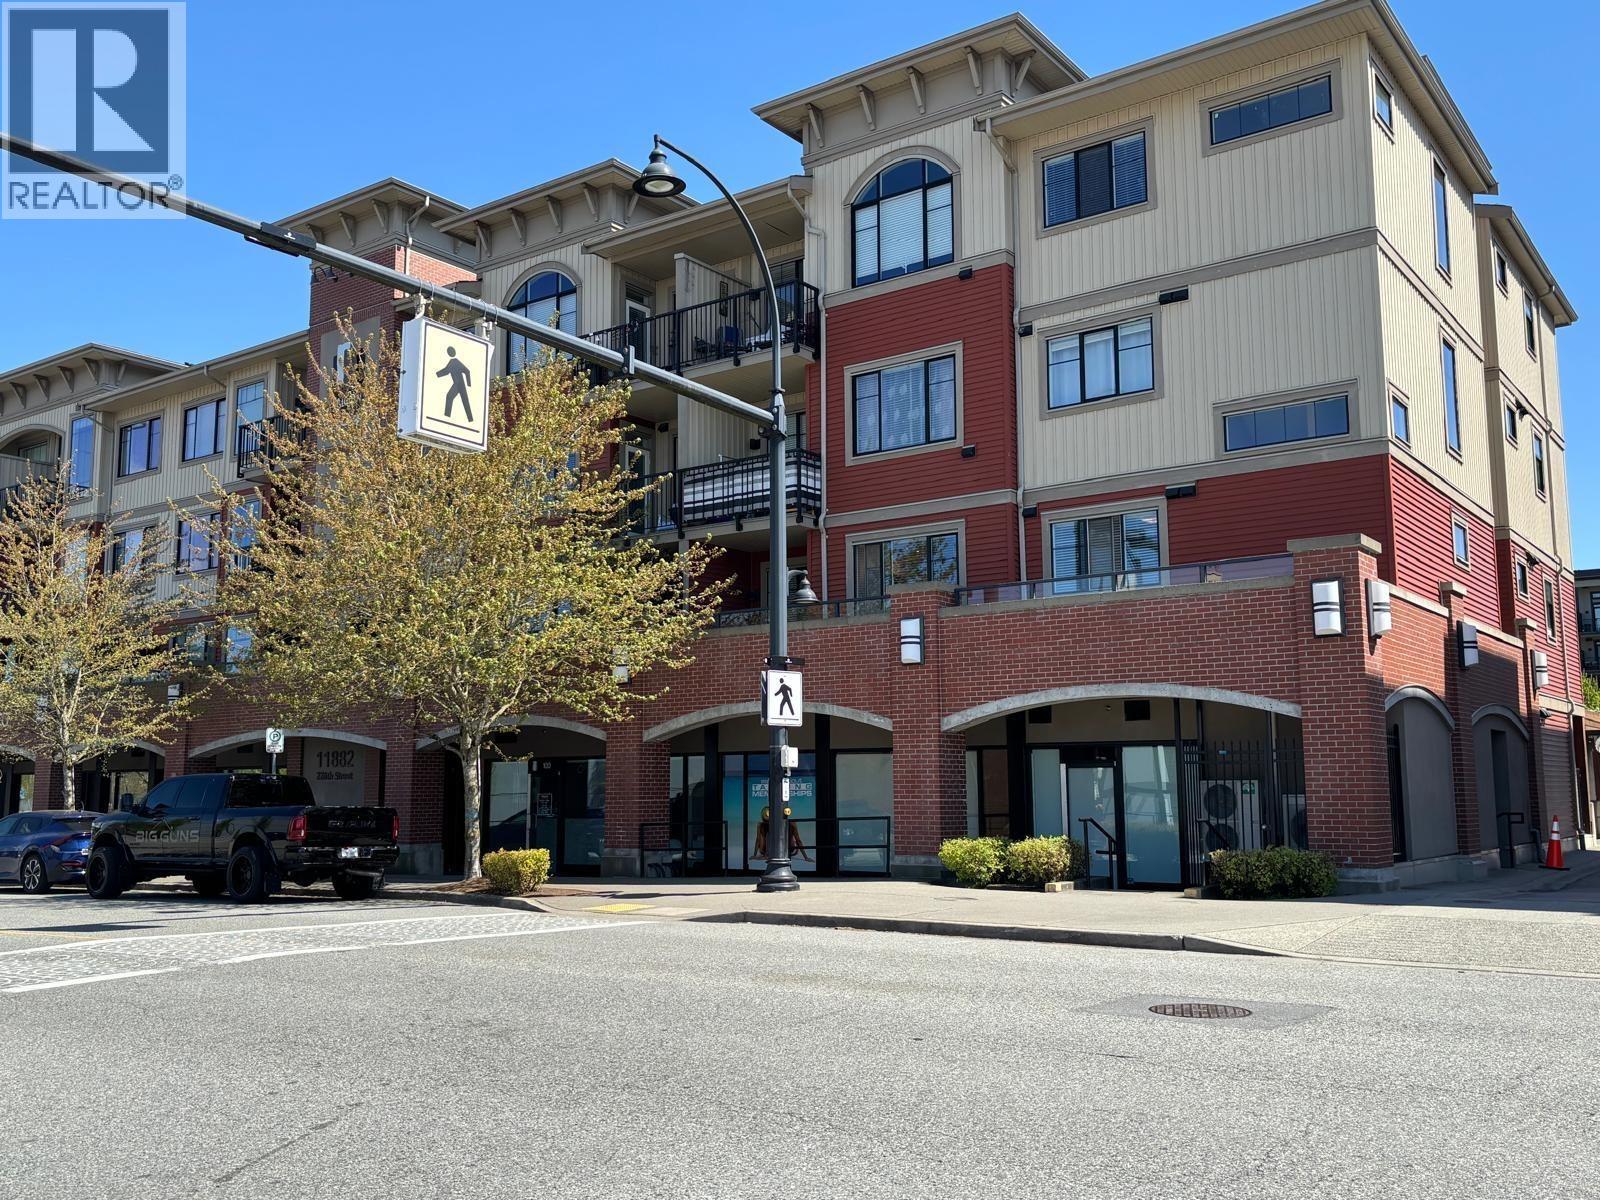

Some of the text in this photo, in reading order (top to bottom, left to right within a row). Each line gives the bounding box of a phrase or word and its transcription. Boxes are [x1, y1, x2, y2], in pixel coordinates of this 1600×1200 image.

[316, 750, 354, 767] 11882
[752, 783, 812, 791] TAING
[136, 830, 200, 842] BIG GUNS
